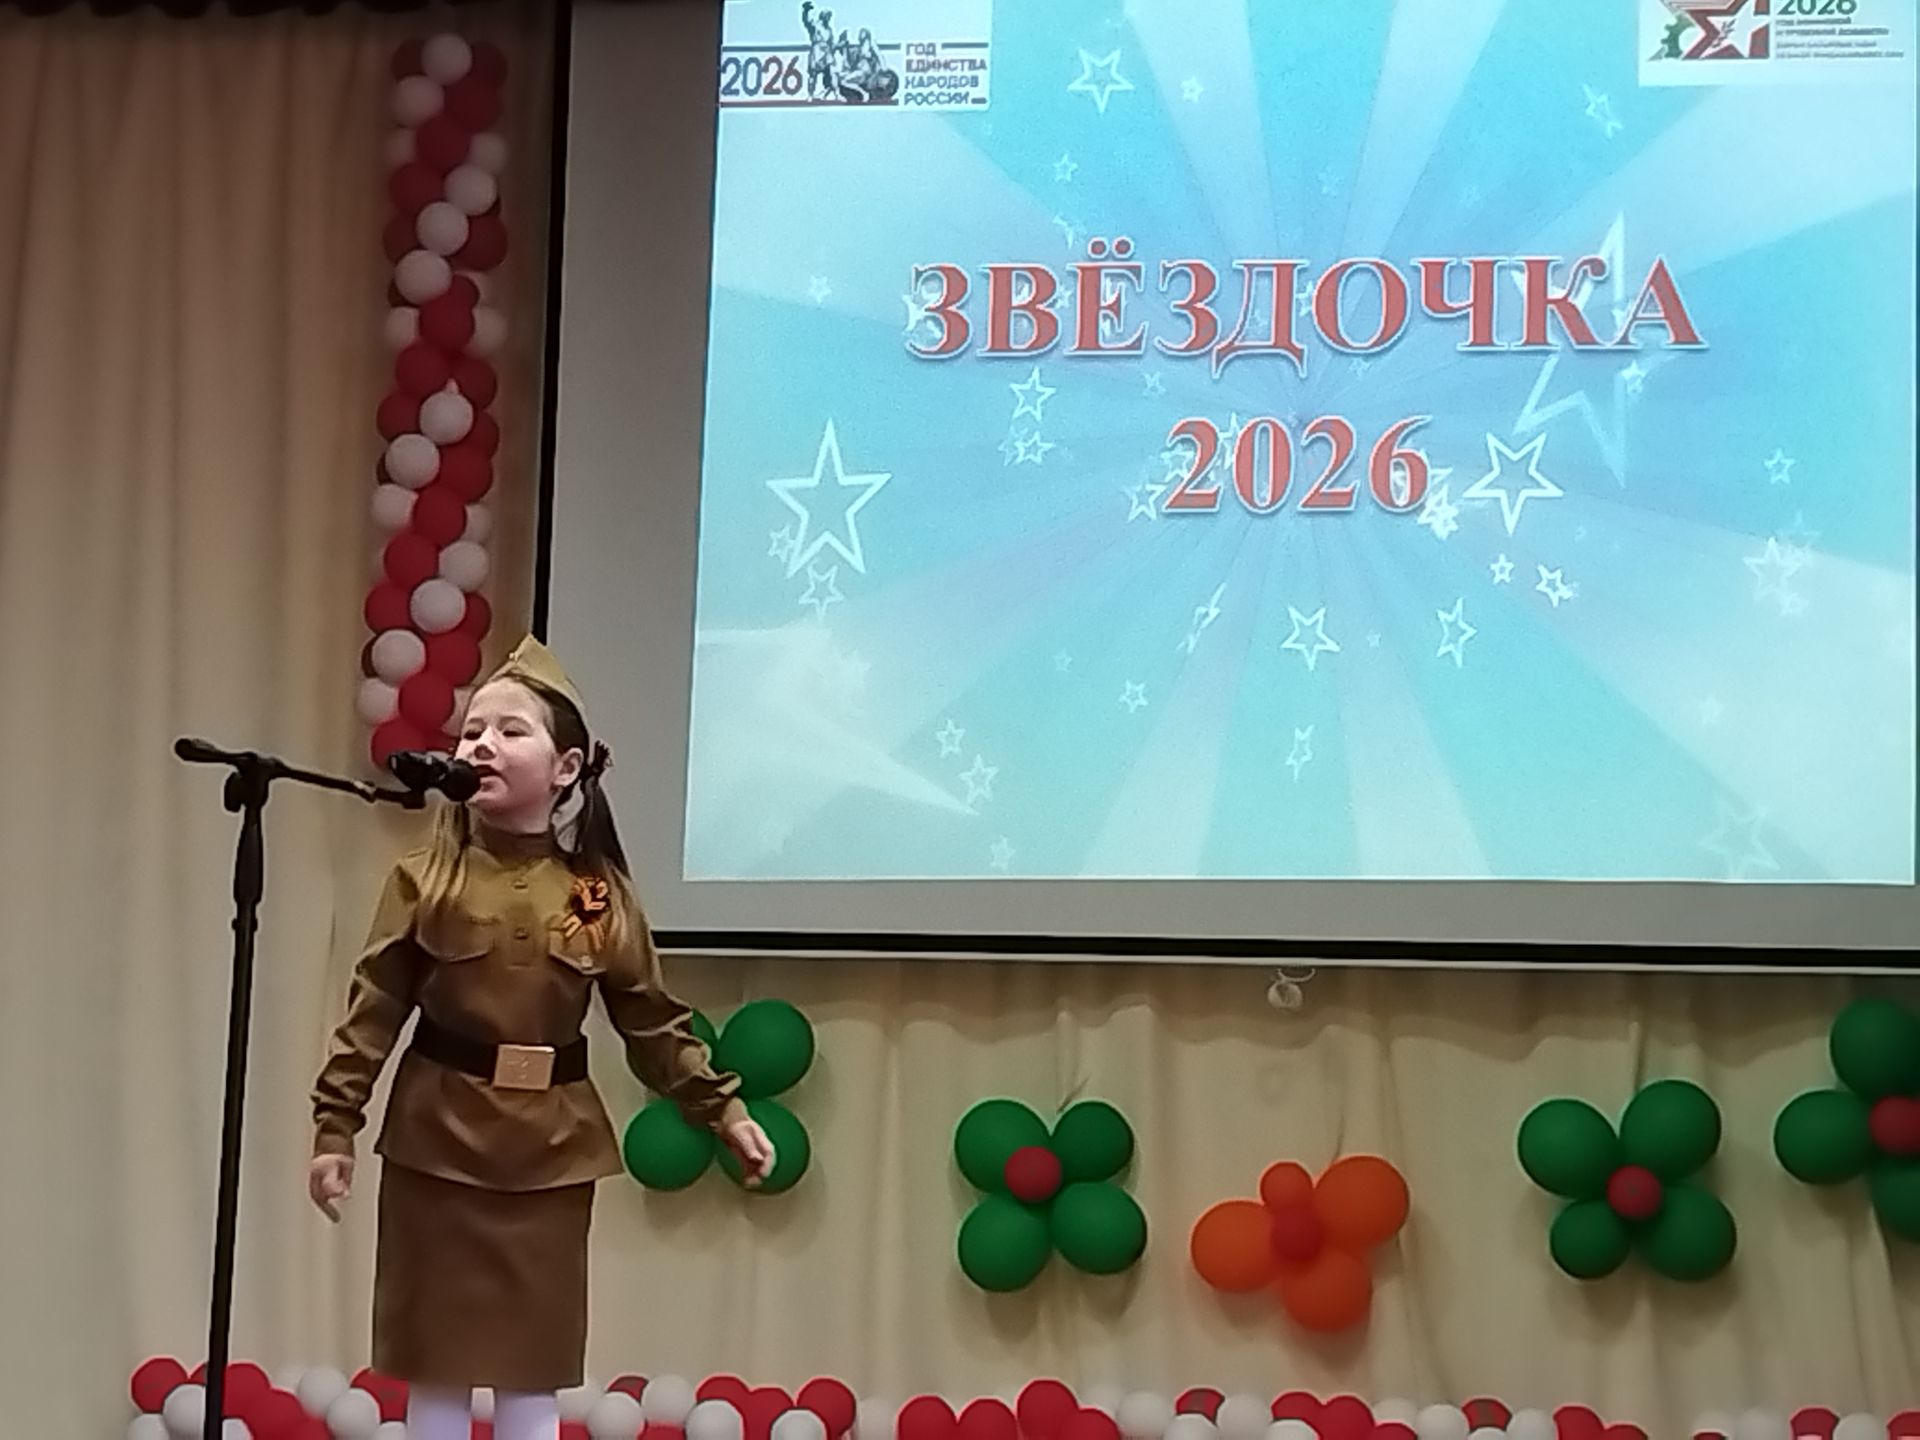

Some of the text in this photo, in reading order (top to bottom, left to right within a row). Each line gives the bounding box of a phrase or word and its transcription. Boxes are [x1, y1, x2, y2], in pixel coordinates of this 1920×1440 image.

[906, 43, 936, 57] ГОД
[906, 59, 987, 73] ЕДИНСТВА
[721, 56, 803, 96] 2026
[904, 75, 979, 90] НАРОДОВ
[904, 91, 969, 106] РОССИИ
[906, 236, 1709, 378] ЗВЁЗДОЧКА
[1162, 414, 1432, 515] 2026
